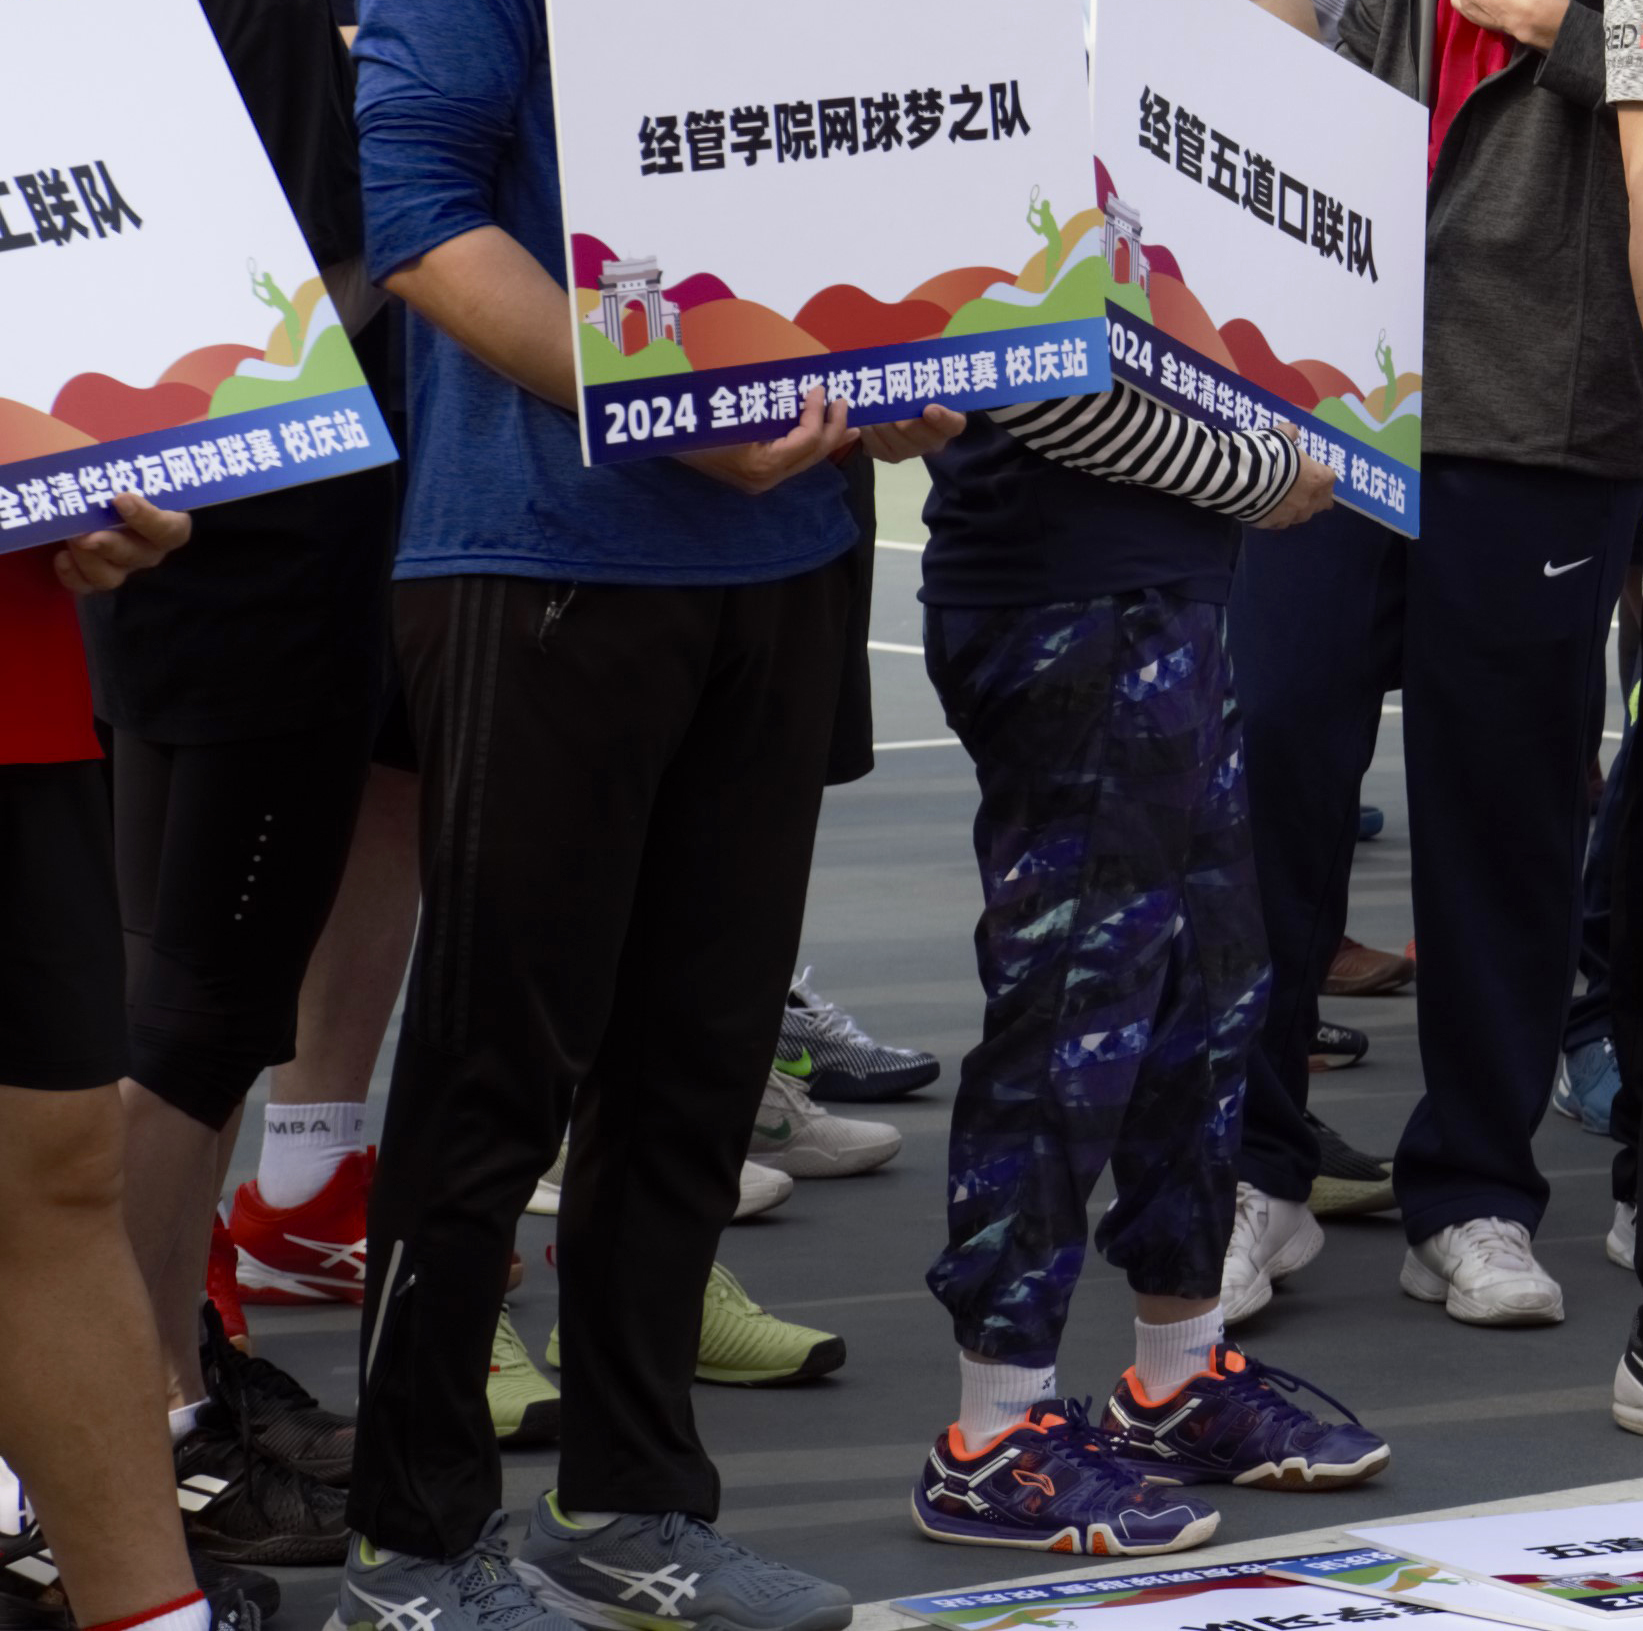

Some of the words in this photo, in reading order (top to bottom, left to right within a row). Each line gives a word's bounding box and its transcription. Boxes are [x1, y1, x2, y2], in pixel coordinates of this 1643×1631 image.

[638, 80, 1031, 176] 经管学院网球梦之队
[1139, 85, 1379, 283] 经管五道口联队
[279, 408, 371, 464] 校庆站
[605, 395, 698, 445] 2024
[1005, 338, 1089, 387] 校庆站
[1351, 456, 1406, 514] 校庆站
